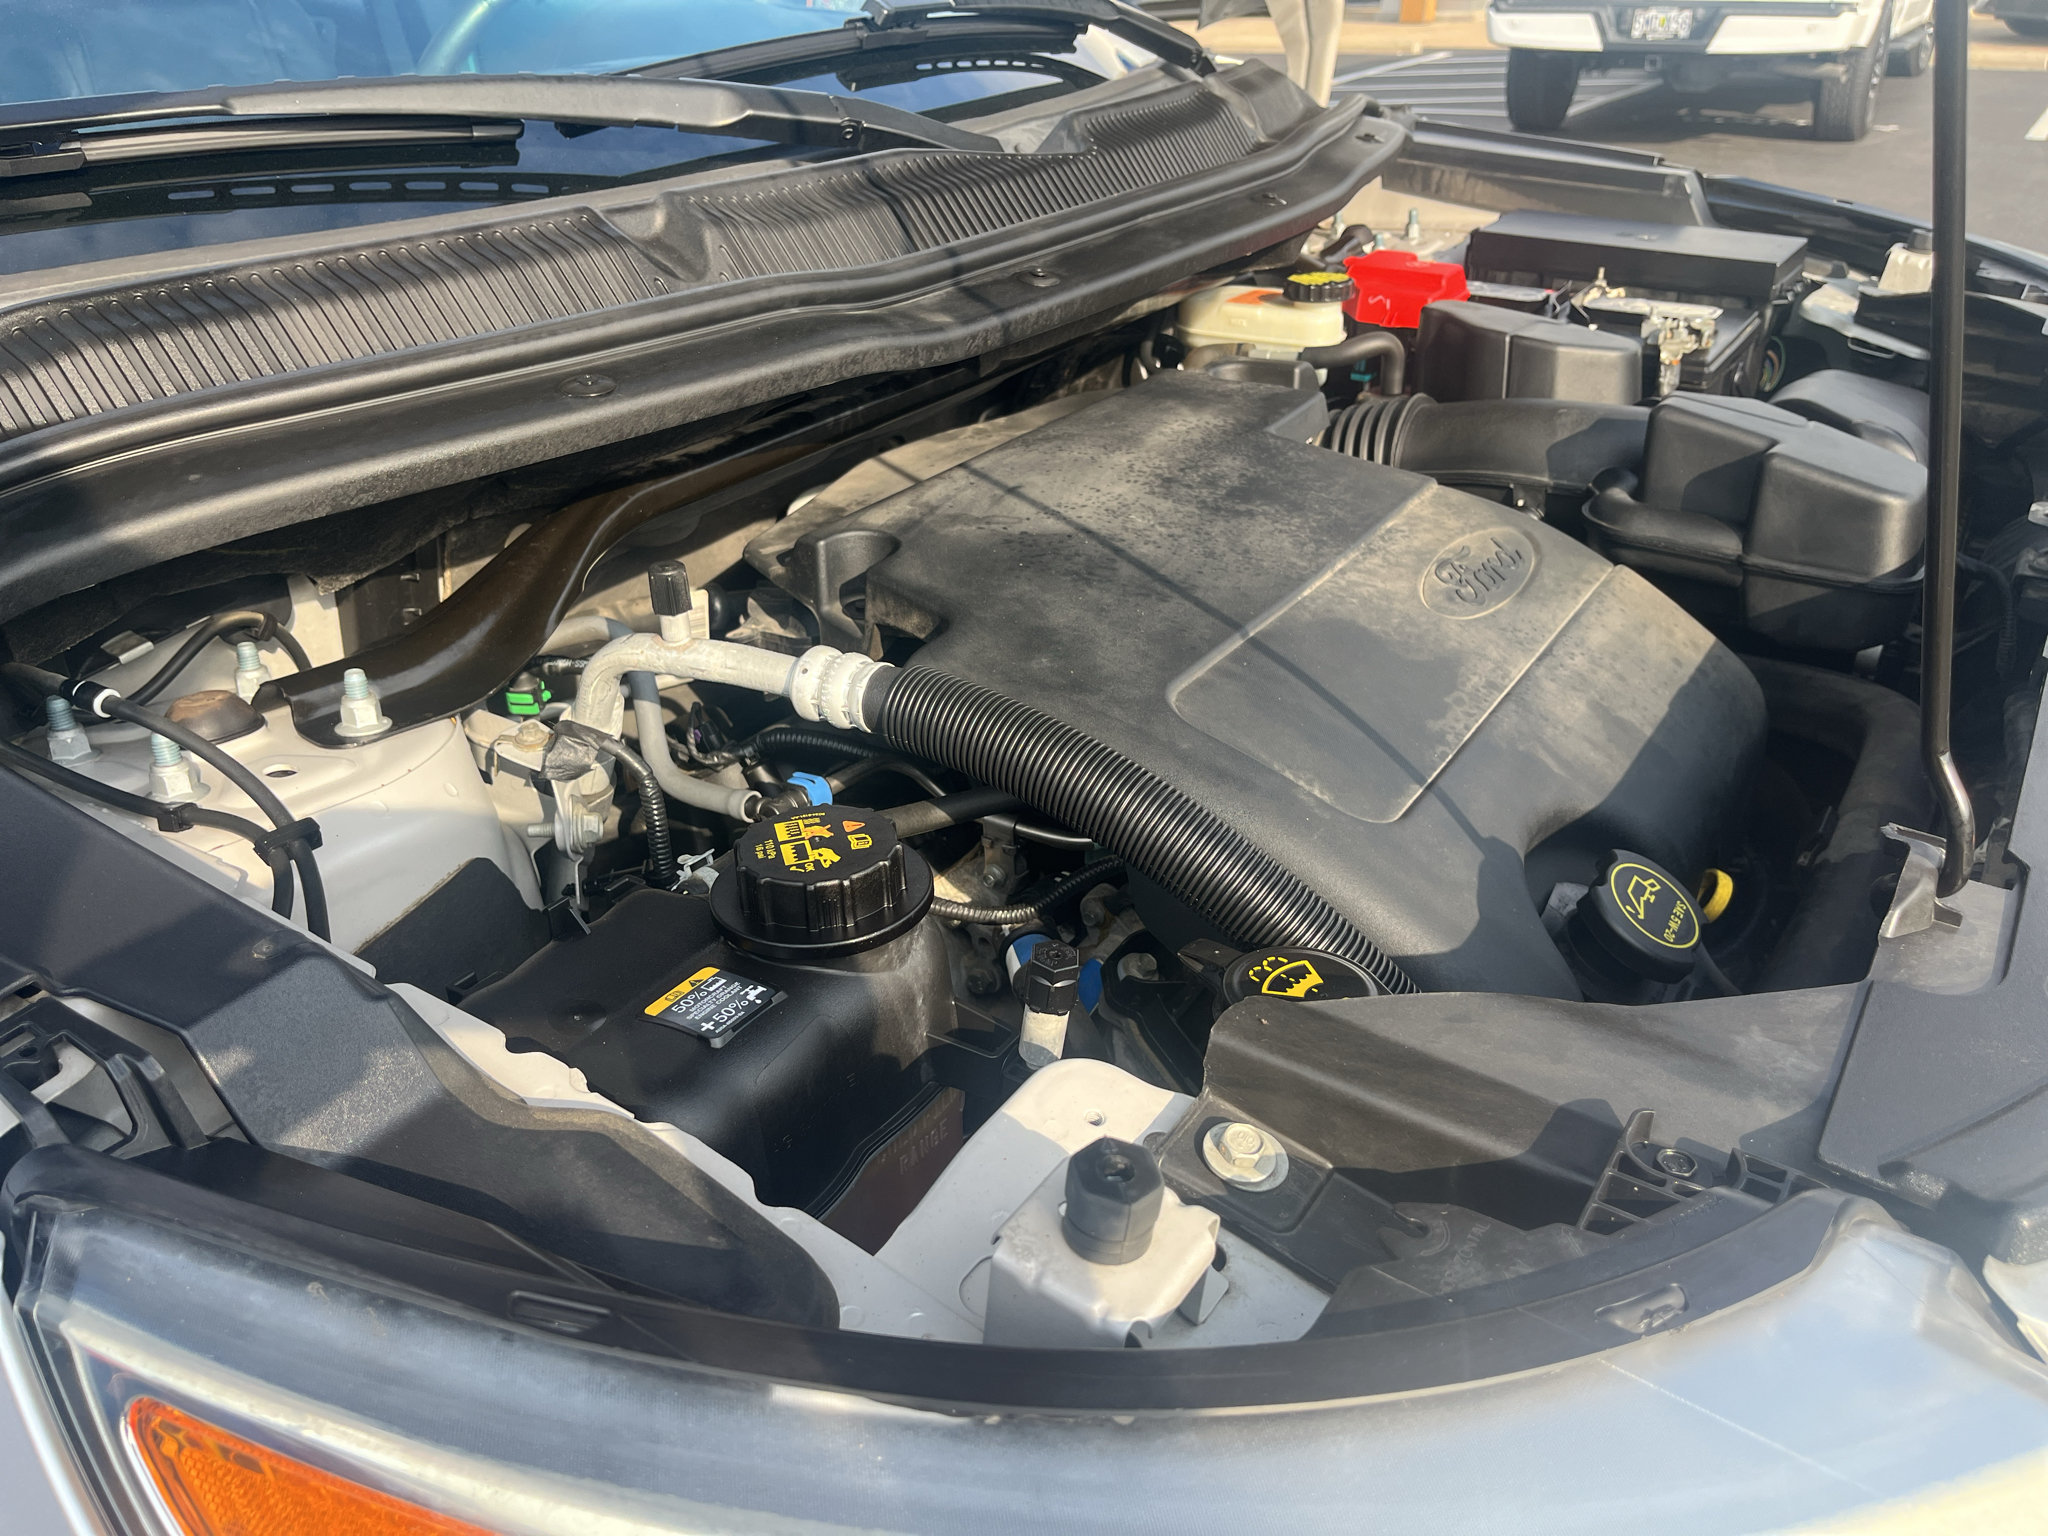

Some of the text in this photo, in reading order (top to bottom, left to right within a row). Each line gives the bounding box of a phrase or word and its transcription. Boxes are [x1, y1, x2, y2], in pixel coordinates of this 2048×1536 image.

[1434, 536, 1523, 606] Ford
[804, 862, 816, 872] OK
[1663, 900, 1687, 942] SAE 5W-20
[671, 991, 708, 1013] 50%
[716, 986, 743, 1004] COOLANT
